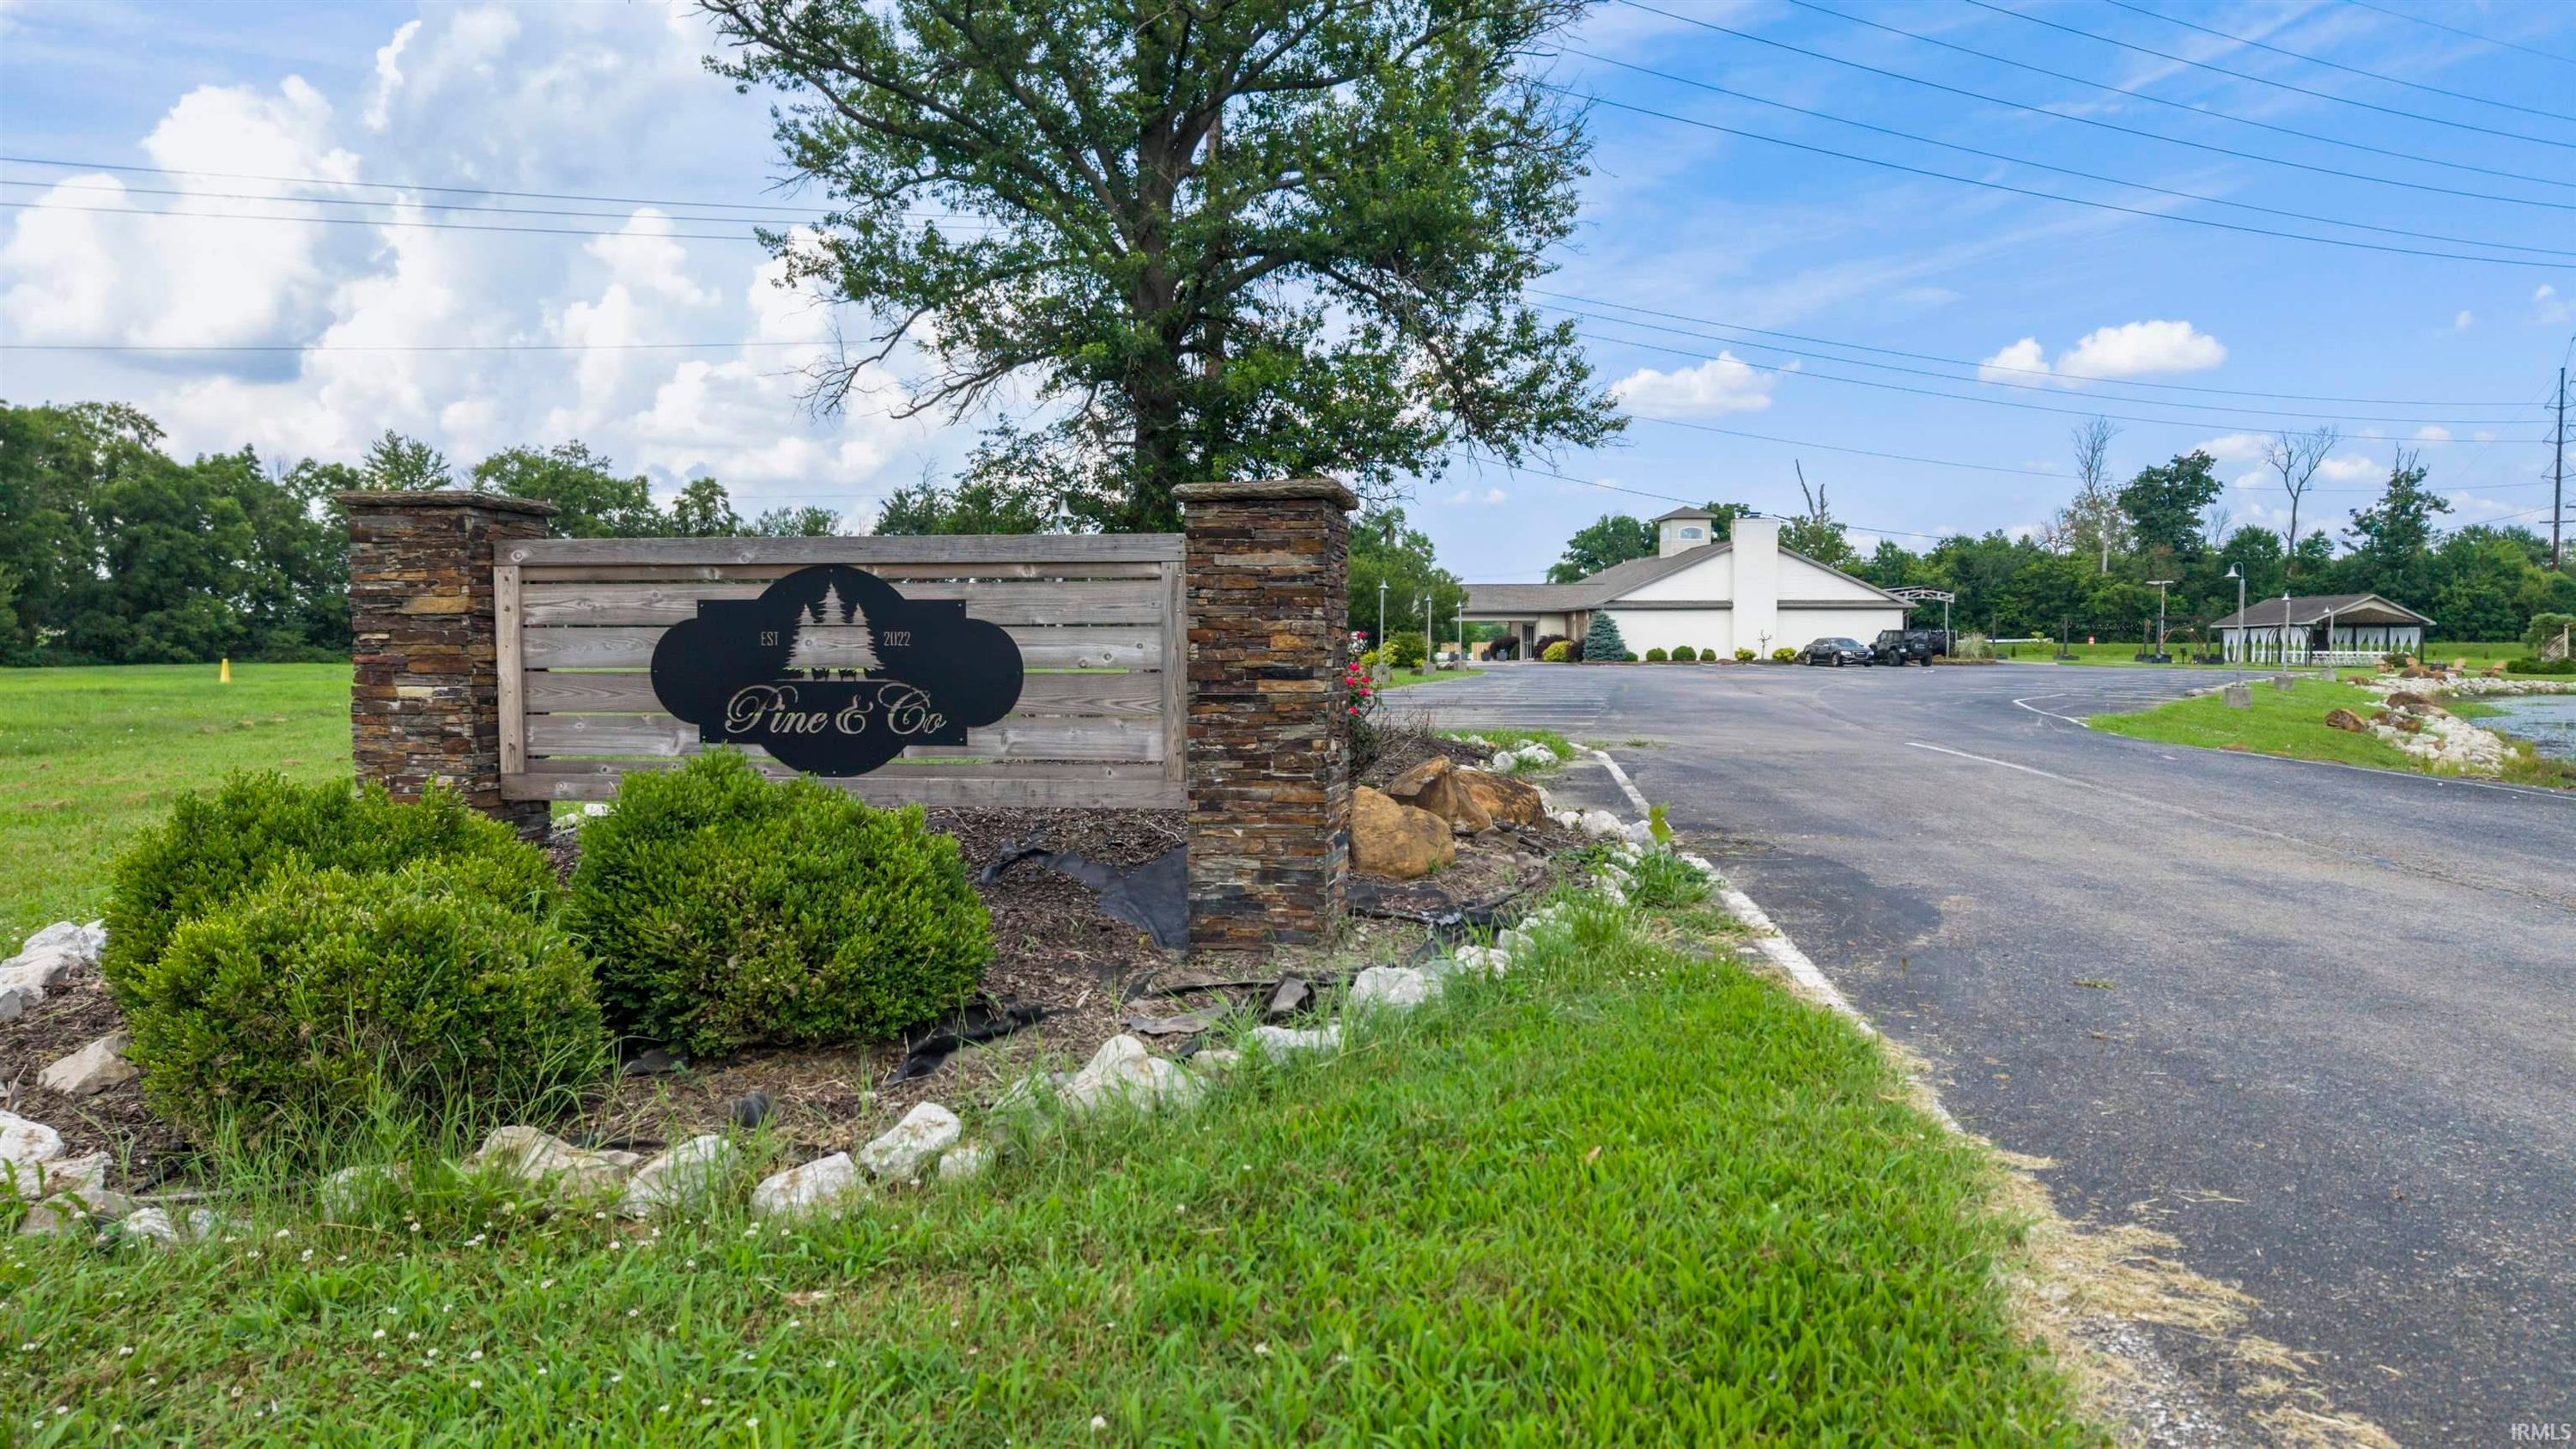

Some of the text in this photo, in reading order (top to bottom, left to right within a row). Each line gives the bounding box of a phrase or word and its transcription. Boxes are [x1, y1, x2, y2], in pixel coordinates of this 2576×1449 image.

[760, 630, 911, 647] EST 2022
[724, 683, 947, 735] Pine & Co
